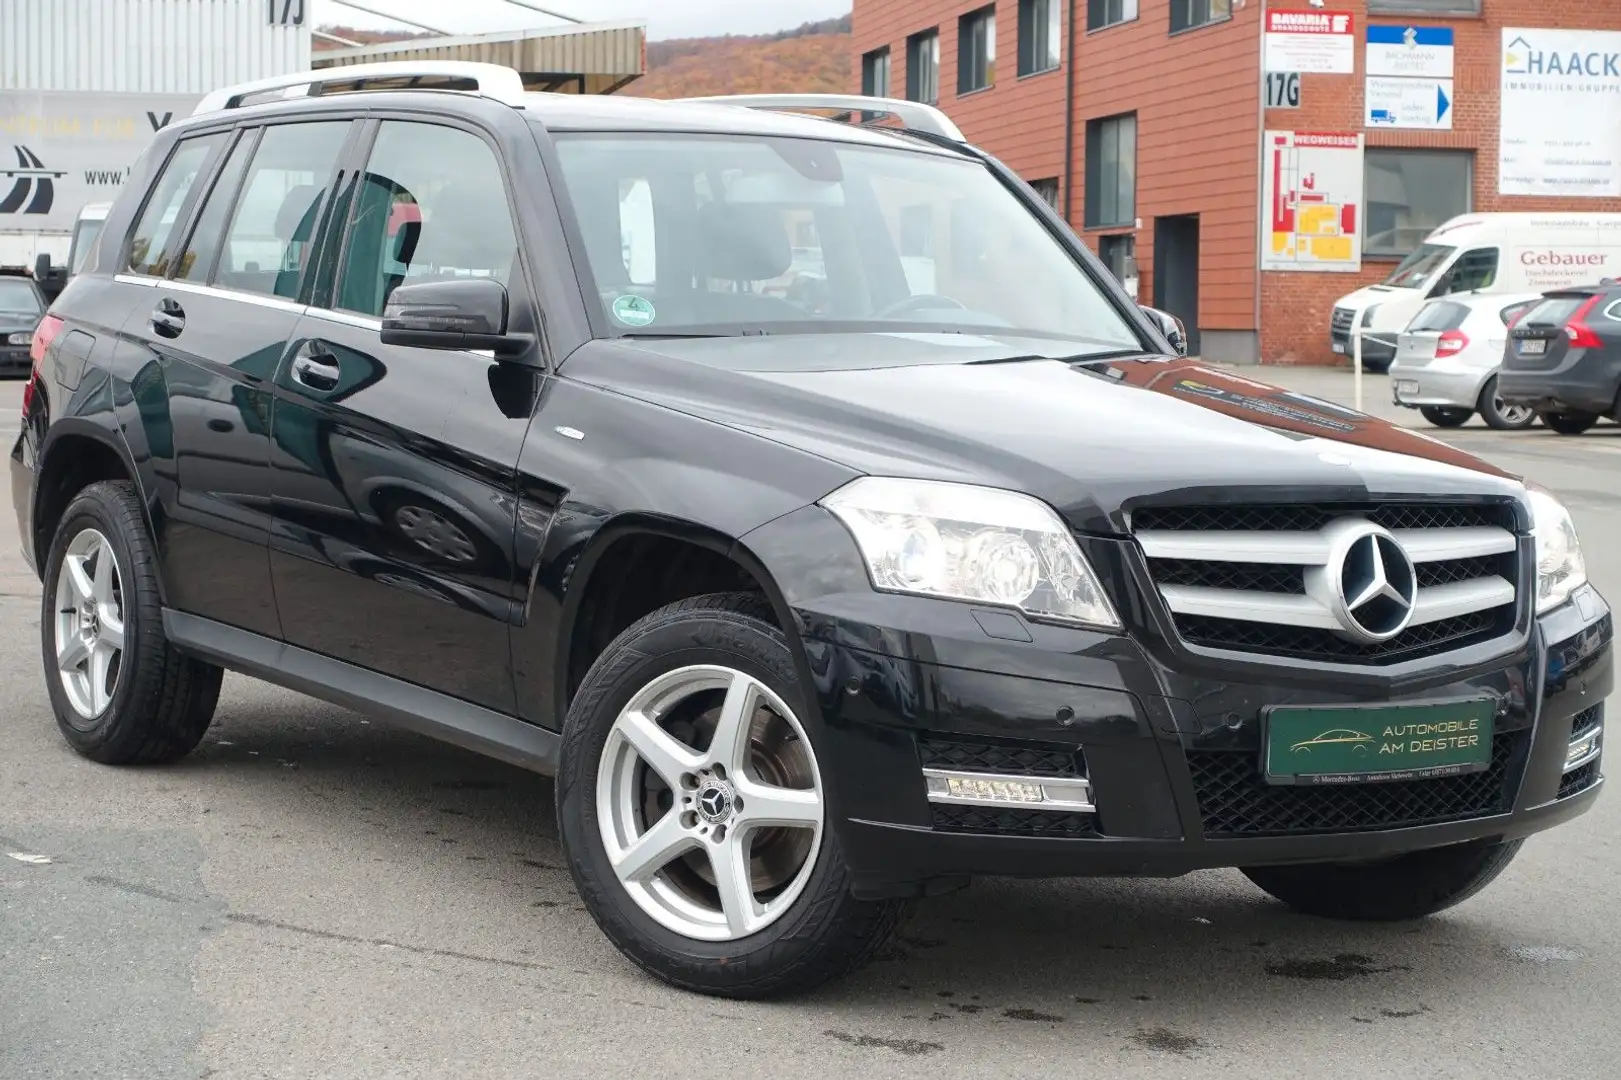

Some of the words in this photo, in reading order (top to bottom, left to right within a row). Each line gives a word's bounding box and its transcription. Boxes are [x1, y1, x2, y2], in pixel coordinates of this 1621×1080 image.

[1271, 13, 1330, 26] BAVARIA
[1528, 50, 1620, 77] HAACK
[1266, 72, 1299, 107] 17G
[1520, 250, 1609, 266] Gebauer
[1382, 718, 1479, 737] AUTOMOBILE
[1379, 742, 1405, 755] AM
[1410, 735, 1479, 753] DEISTER
